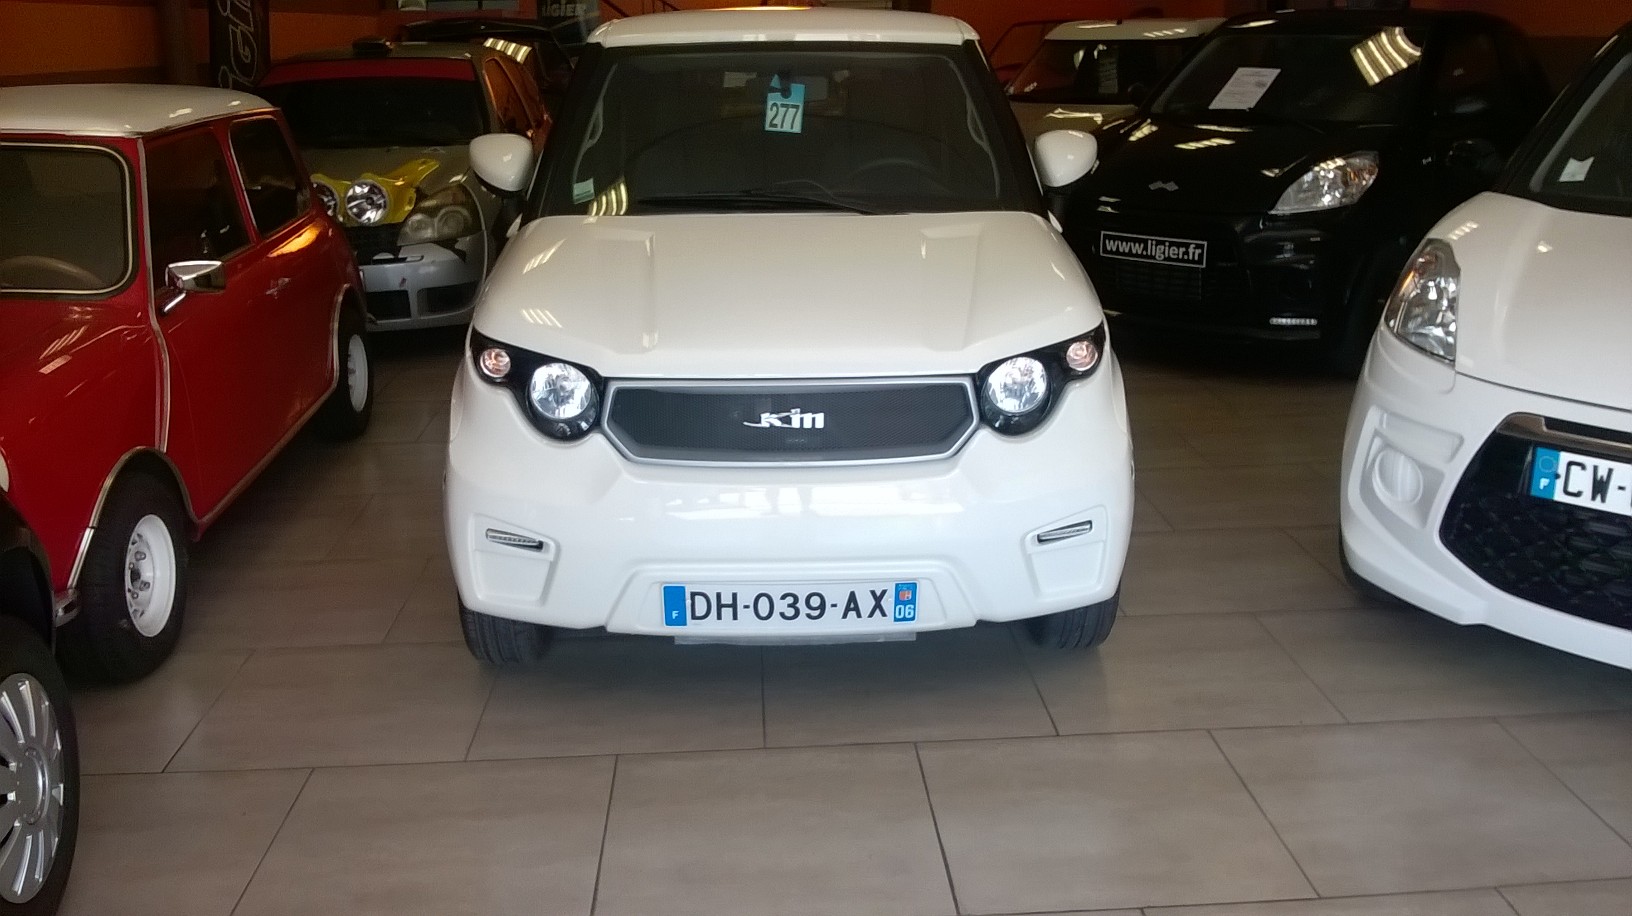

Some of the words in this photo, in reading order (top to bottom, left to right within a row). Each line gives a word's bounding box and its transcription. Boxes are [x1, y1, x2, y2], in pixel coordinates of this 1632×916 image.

[768, 102, 800, 130] 277
[1105, 239, 1202, 261] www.ligier.fr
[1563, 461, 1632, 508] CW-
[672, 610, 680, 620] F
[690, 589, 888, 621] DH-039-AX
[895, 604, 915, 619] 06
